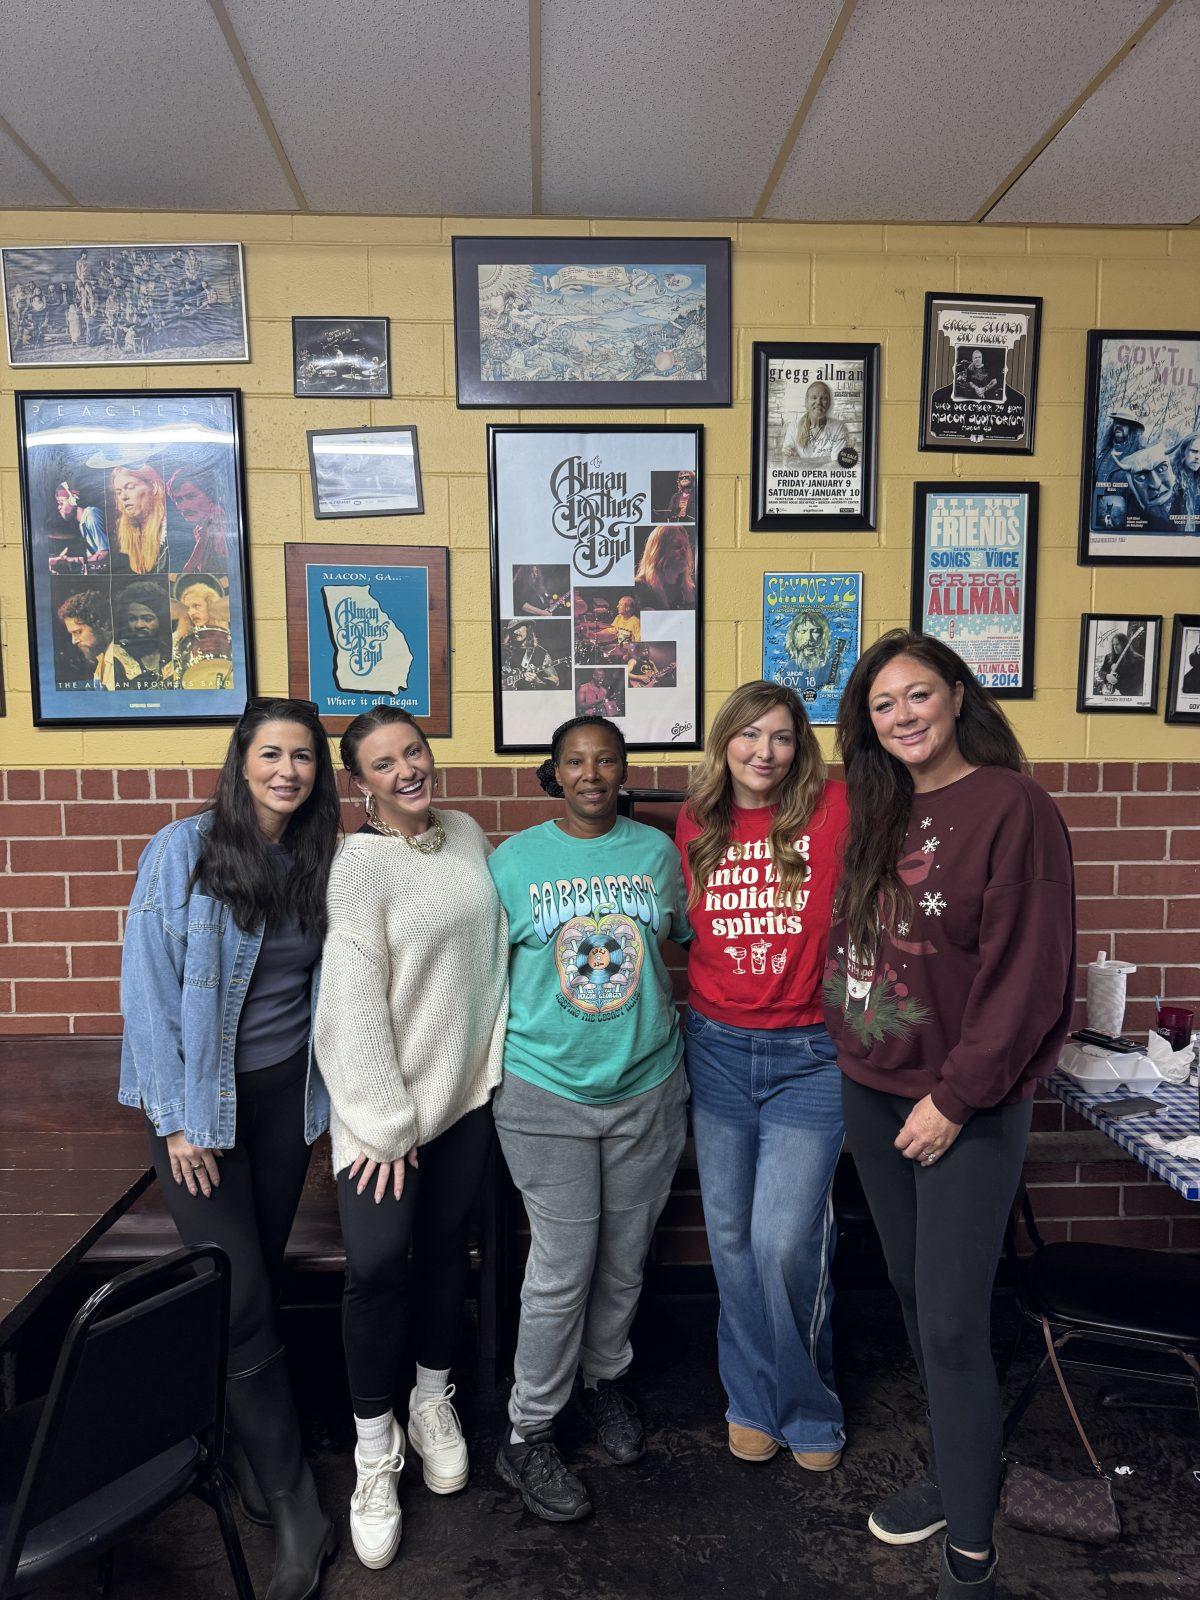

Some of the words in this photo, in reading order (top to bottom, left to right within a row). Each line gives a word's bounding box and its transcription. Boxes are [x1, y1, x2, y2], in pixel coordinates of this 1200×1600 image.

[1117, 344, 1180, 367] GOV'T
[769, 367, 810, 384] gregg
[816, 363, 864, 382] allman
[953, 402, 992, 412] DECEMBER
[772, 470, 799, 478] GRAND
[802, 470, 828, 478] OPERA
[830, 470, 857, 478] HOUSE
[849, 489, 860, 497] 10
[932, 498, 980, 517] ALL
[984, 497, 1020, 517] MY
[929, 515, 1021, 547] FRIENDS
[930, 551, 970, 568] SONGS
[986, 551, 1019, 568] VOICE
[322, 572, 371, 582] MACON,
[928, 573, 1021, 587] GREGG
[927, 587, 1020, 616] ALLMAN
[976, 664, 1007, 674] ATLANTA,
[1008, 664, 1020, 673] GA
[774, 677, 800, 687] NOV
[804, 676, 816, 687] 18
[992, 673, 1019, 687] 2014
[326, 696, 356, 706] Where
[360, 697, 368, 706] it
[371, 697, 385, 706] all
[389, 697, 418, 709] Began
[719, 835, 811, 865] ettig
[706, 865, 760, 888] into
[528, 874, 661, 944] GABBAFEST
[711, 911, 803, 939] spirits
[581, 1013, 596, 1023] THE
